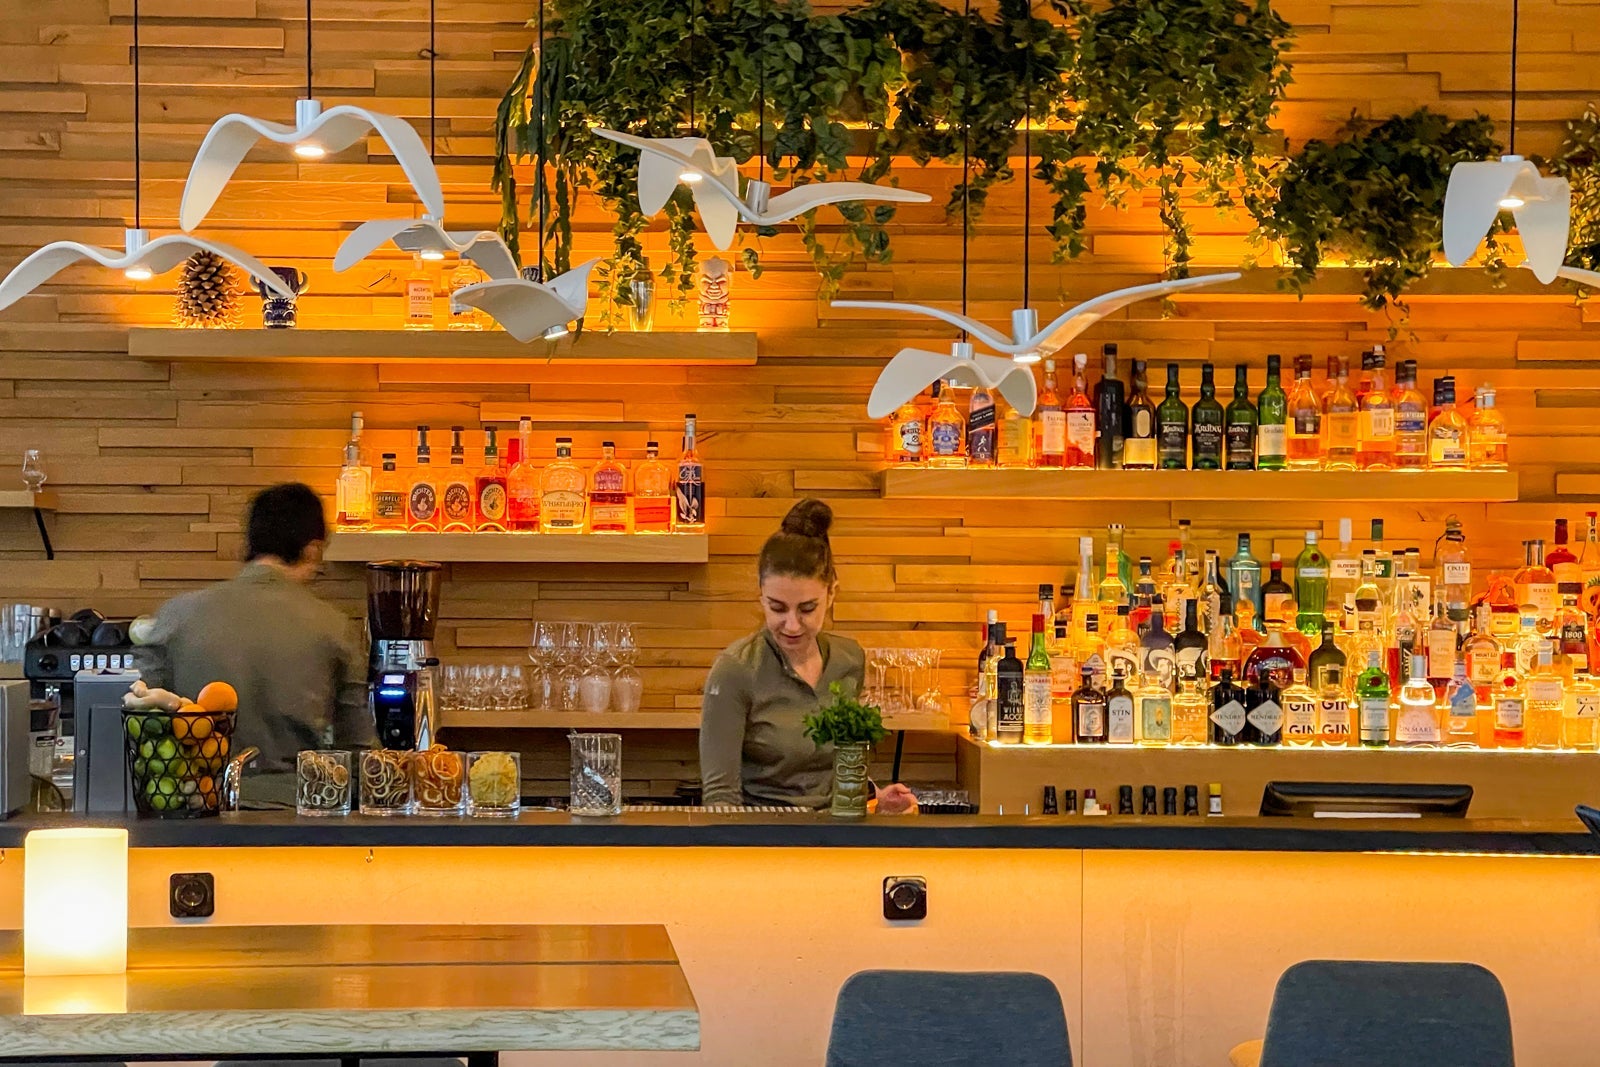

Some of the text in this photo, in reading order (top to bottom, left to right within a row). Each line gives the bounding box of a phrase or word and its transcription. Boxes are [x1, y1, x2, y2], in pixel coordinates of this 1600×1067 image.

[1564, 631, 1583, 639] 1800
[1289, 703, 1315, 712] GIN
[1321, 701, 1348, 710] GIN
[1289, 724, 1315, 734] GIN
[1322, 724, 1350, 735] GIN
